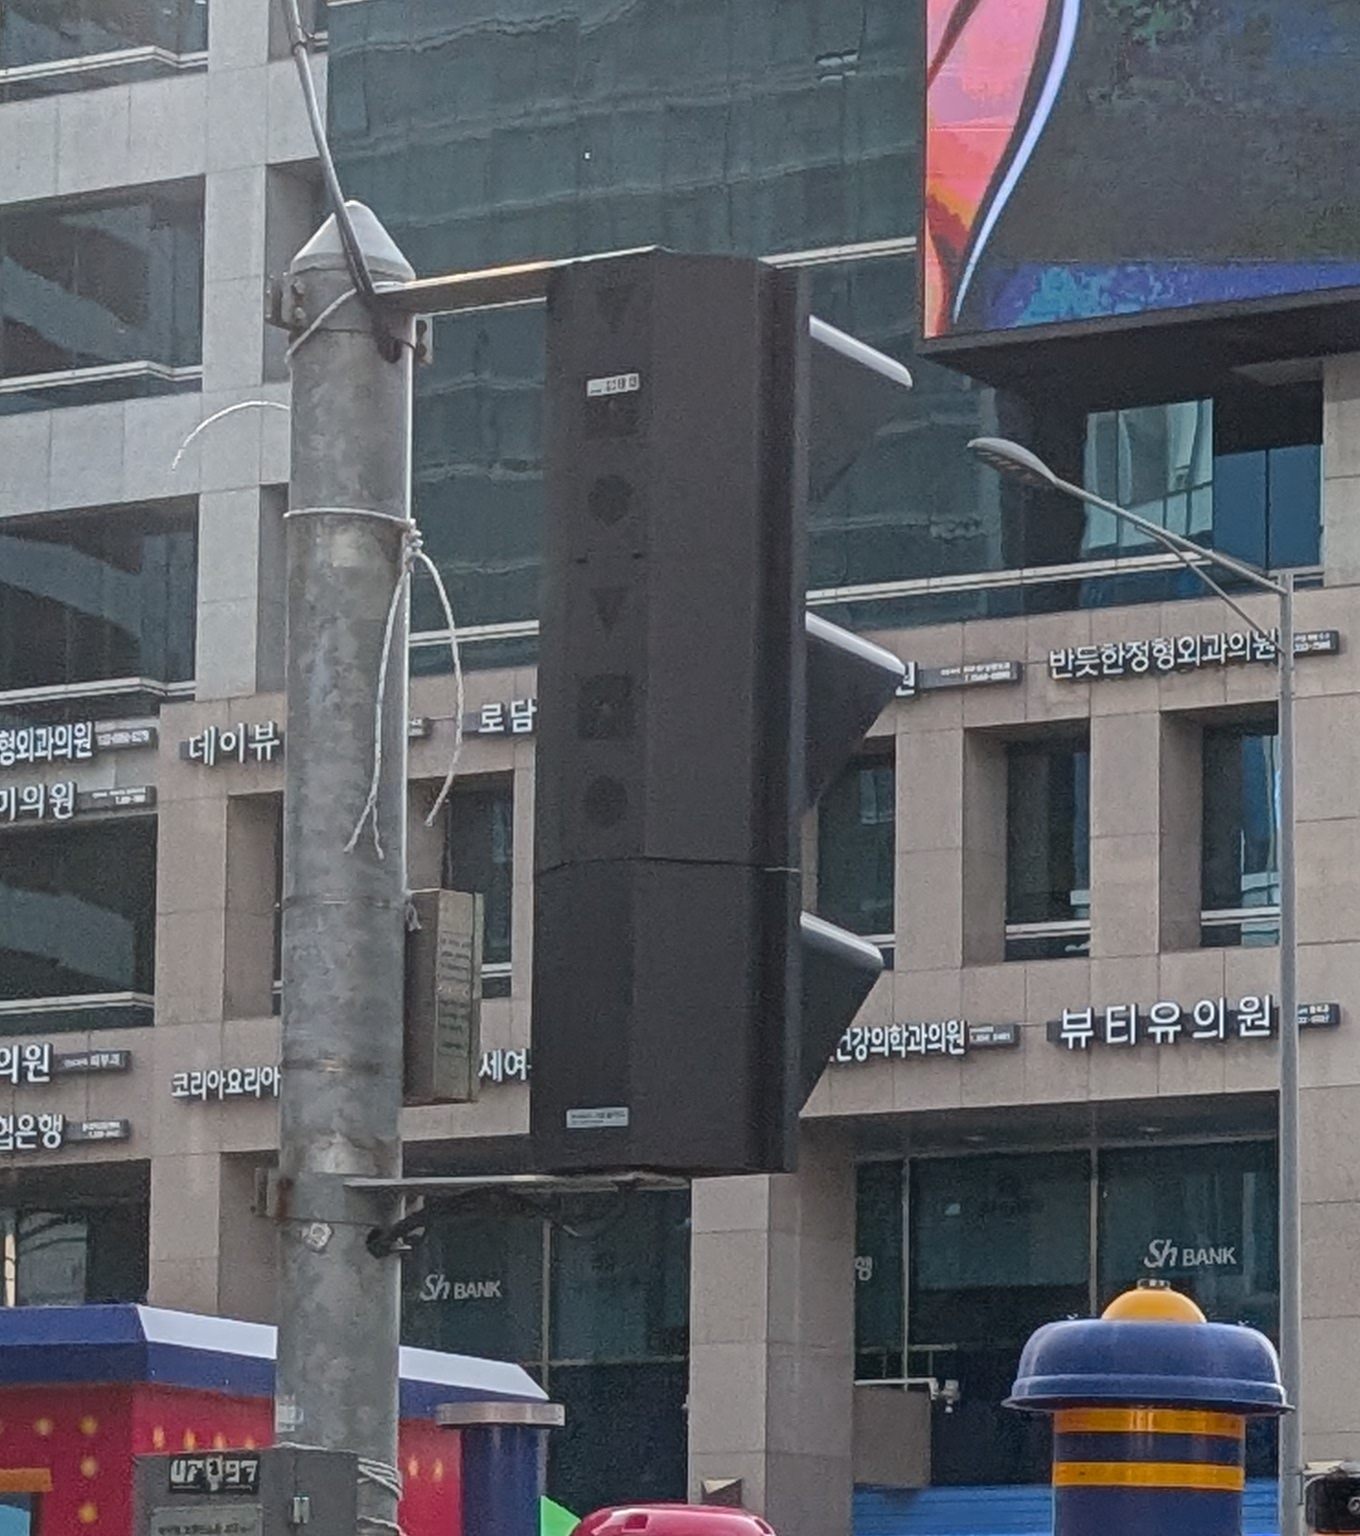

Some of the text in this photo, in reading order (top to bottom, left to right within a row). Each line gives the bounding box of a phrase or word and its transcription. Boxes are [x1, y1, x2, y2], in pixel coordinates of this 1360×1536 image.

[1050, 630, 1279, 679] 반듯한정형외과의원
[189, 721, 280, 765] 데이뷰
[1060, 995, 1272, 1050] 뷰티유의원
[478, 1048, 532, 1081] 세여
[172, 1065, 281, 1099] 코리아요리아
[1182, 1247, 1237, 1267] BANK
[453, 1279, 502, 1300] BANK
